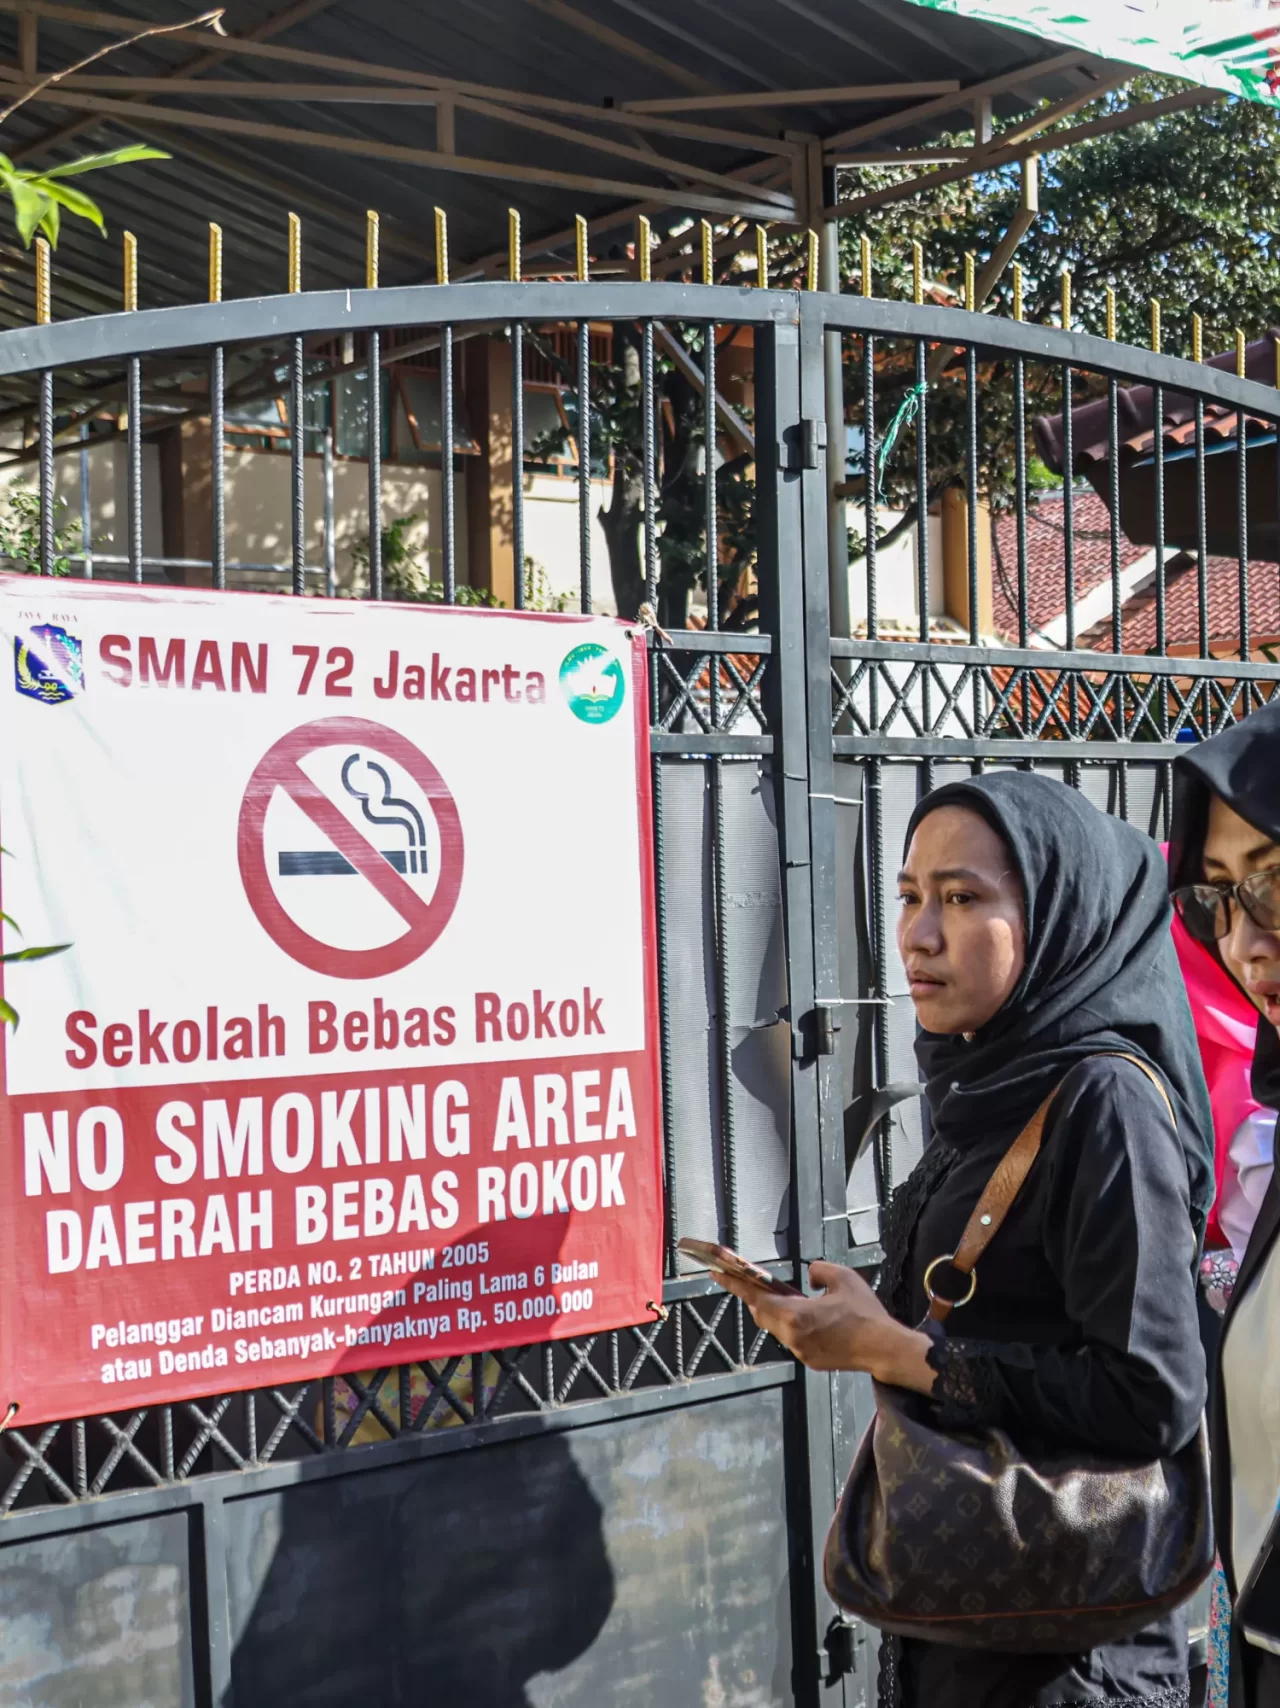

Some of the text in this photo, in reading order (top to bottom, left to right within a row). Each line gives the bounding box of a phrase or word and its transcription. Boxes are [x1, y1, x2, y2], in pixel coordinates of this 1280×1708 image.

[100, 634, 546, 705] SMAN 72 Jakarta
[65, 987, 606, 1069] Sekolah Bebas Rokok
[24, 1066, 638, 1197] NO SMOKING AREA
[46, 1151, 627, 1275] DAERAH BEBAS ROKOK
[91, 1260, 599, 1350] Pelanggar Diancam Kurungan Paling Lama 6 Bulan
[229, 1241, 490, 1297] PERDA NO. 2 TAHUN 2005
[101, 1288, 594, 1384] atau Denda Sebanyak-banyaknya Rp. 50.000.000
